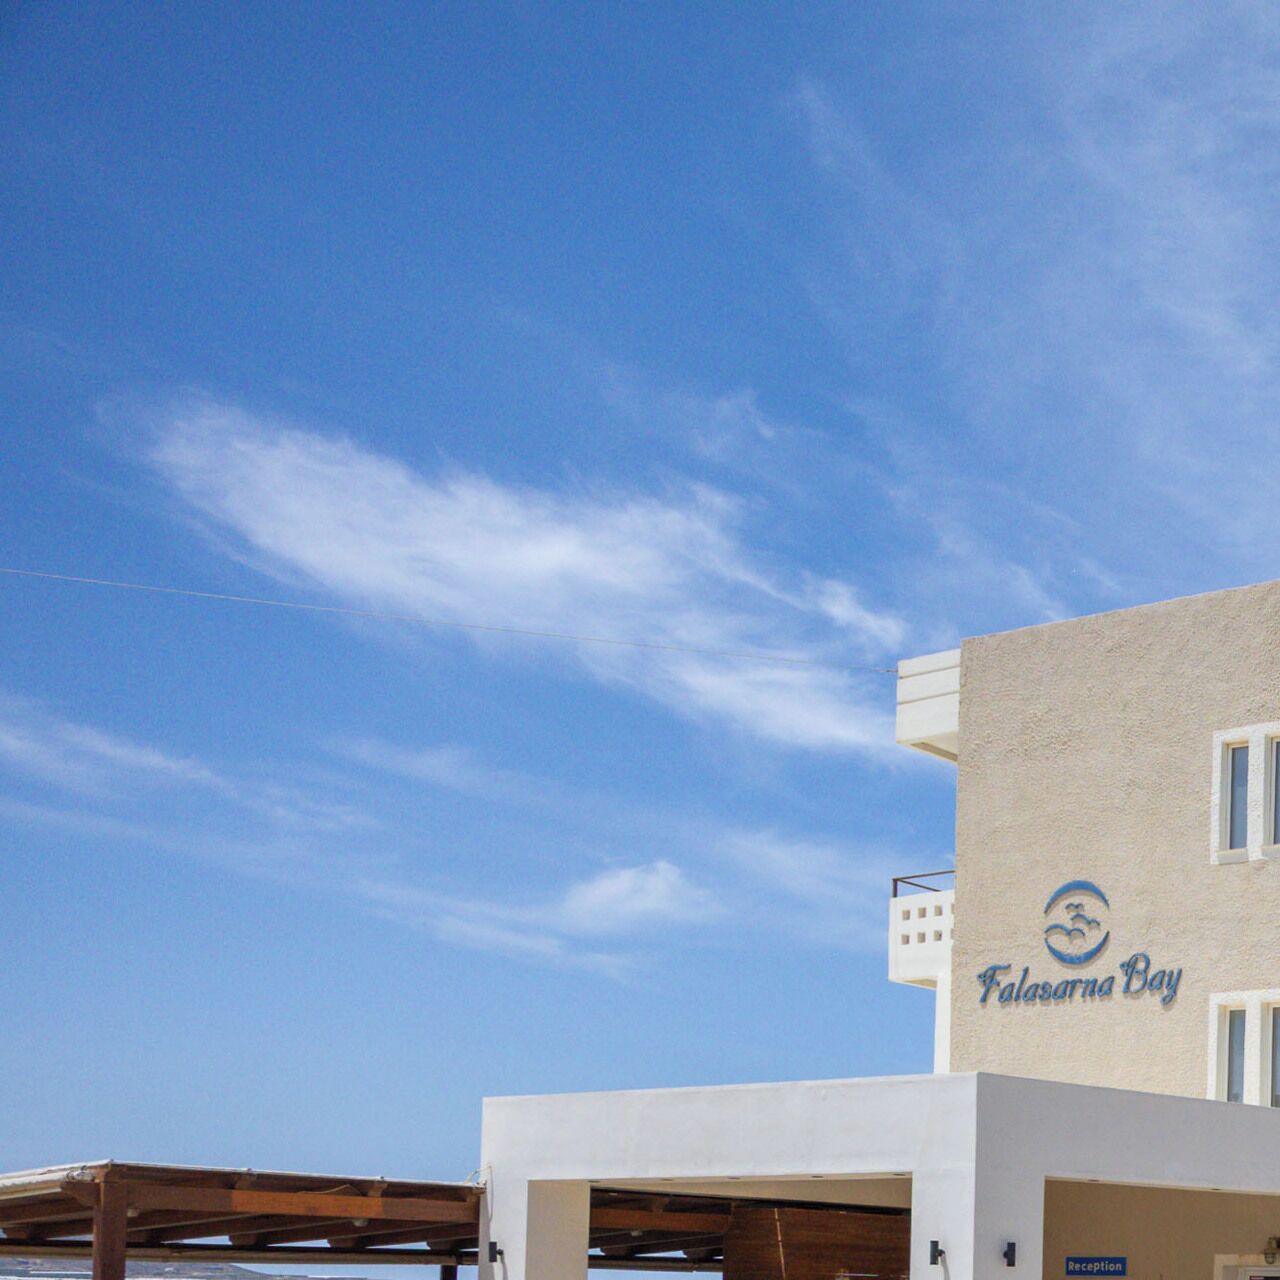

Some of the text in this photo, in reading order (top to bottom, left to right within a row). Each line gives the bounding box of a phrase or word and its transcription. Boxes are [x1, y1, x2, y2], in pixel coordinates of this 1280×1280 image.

[977, 952, 1182, 1005] Falasarna Bay
[1068, 1261, 1122, 1273] Reception
